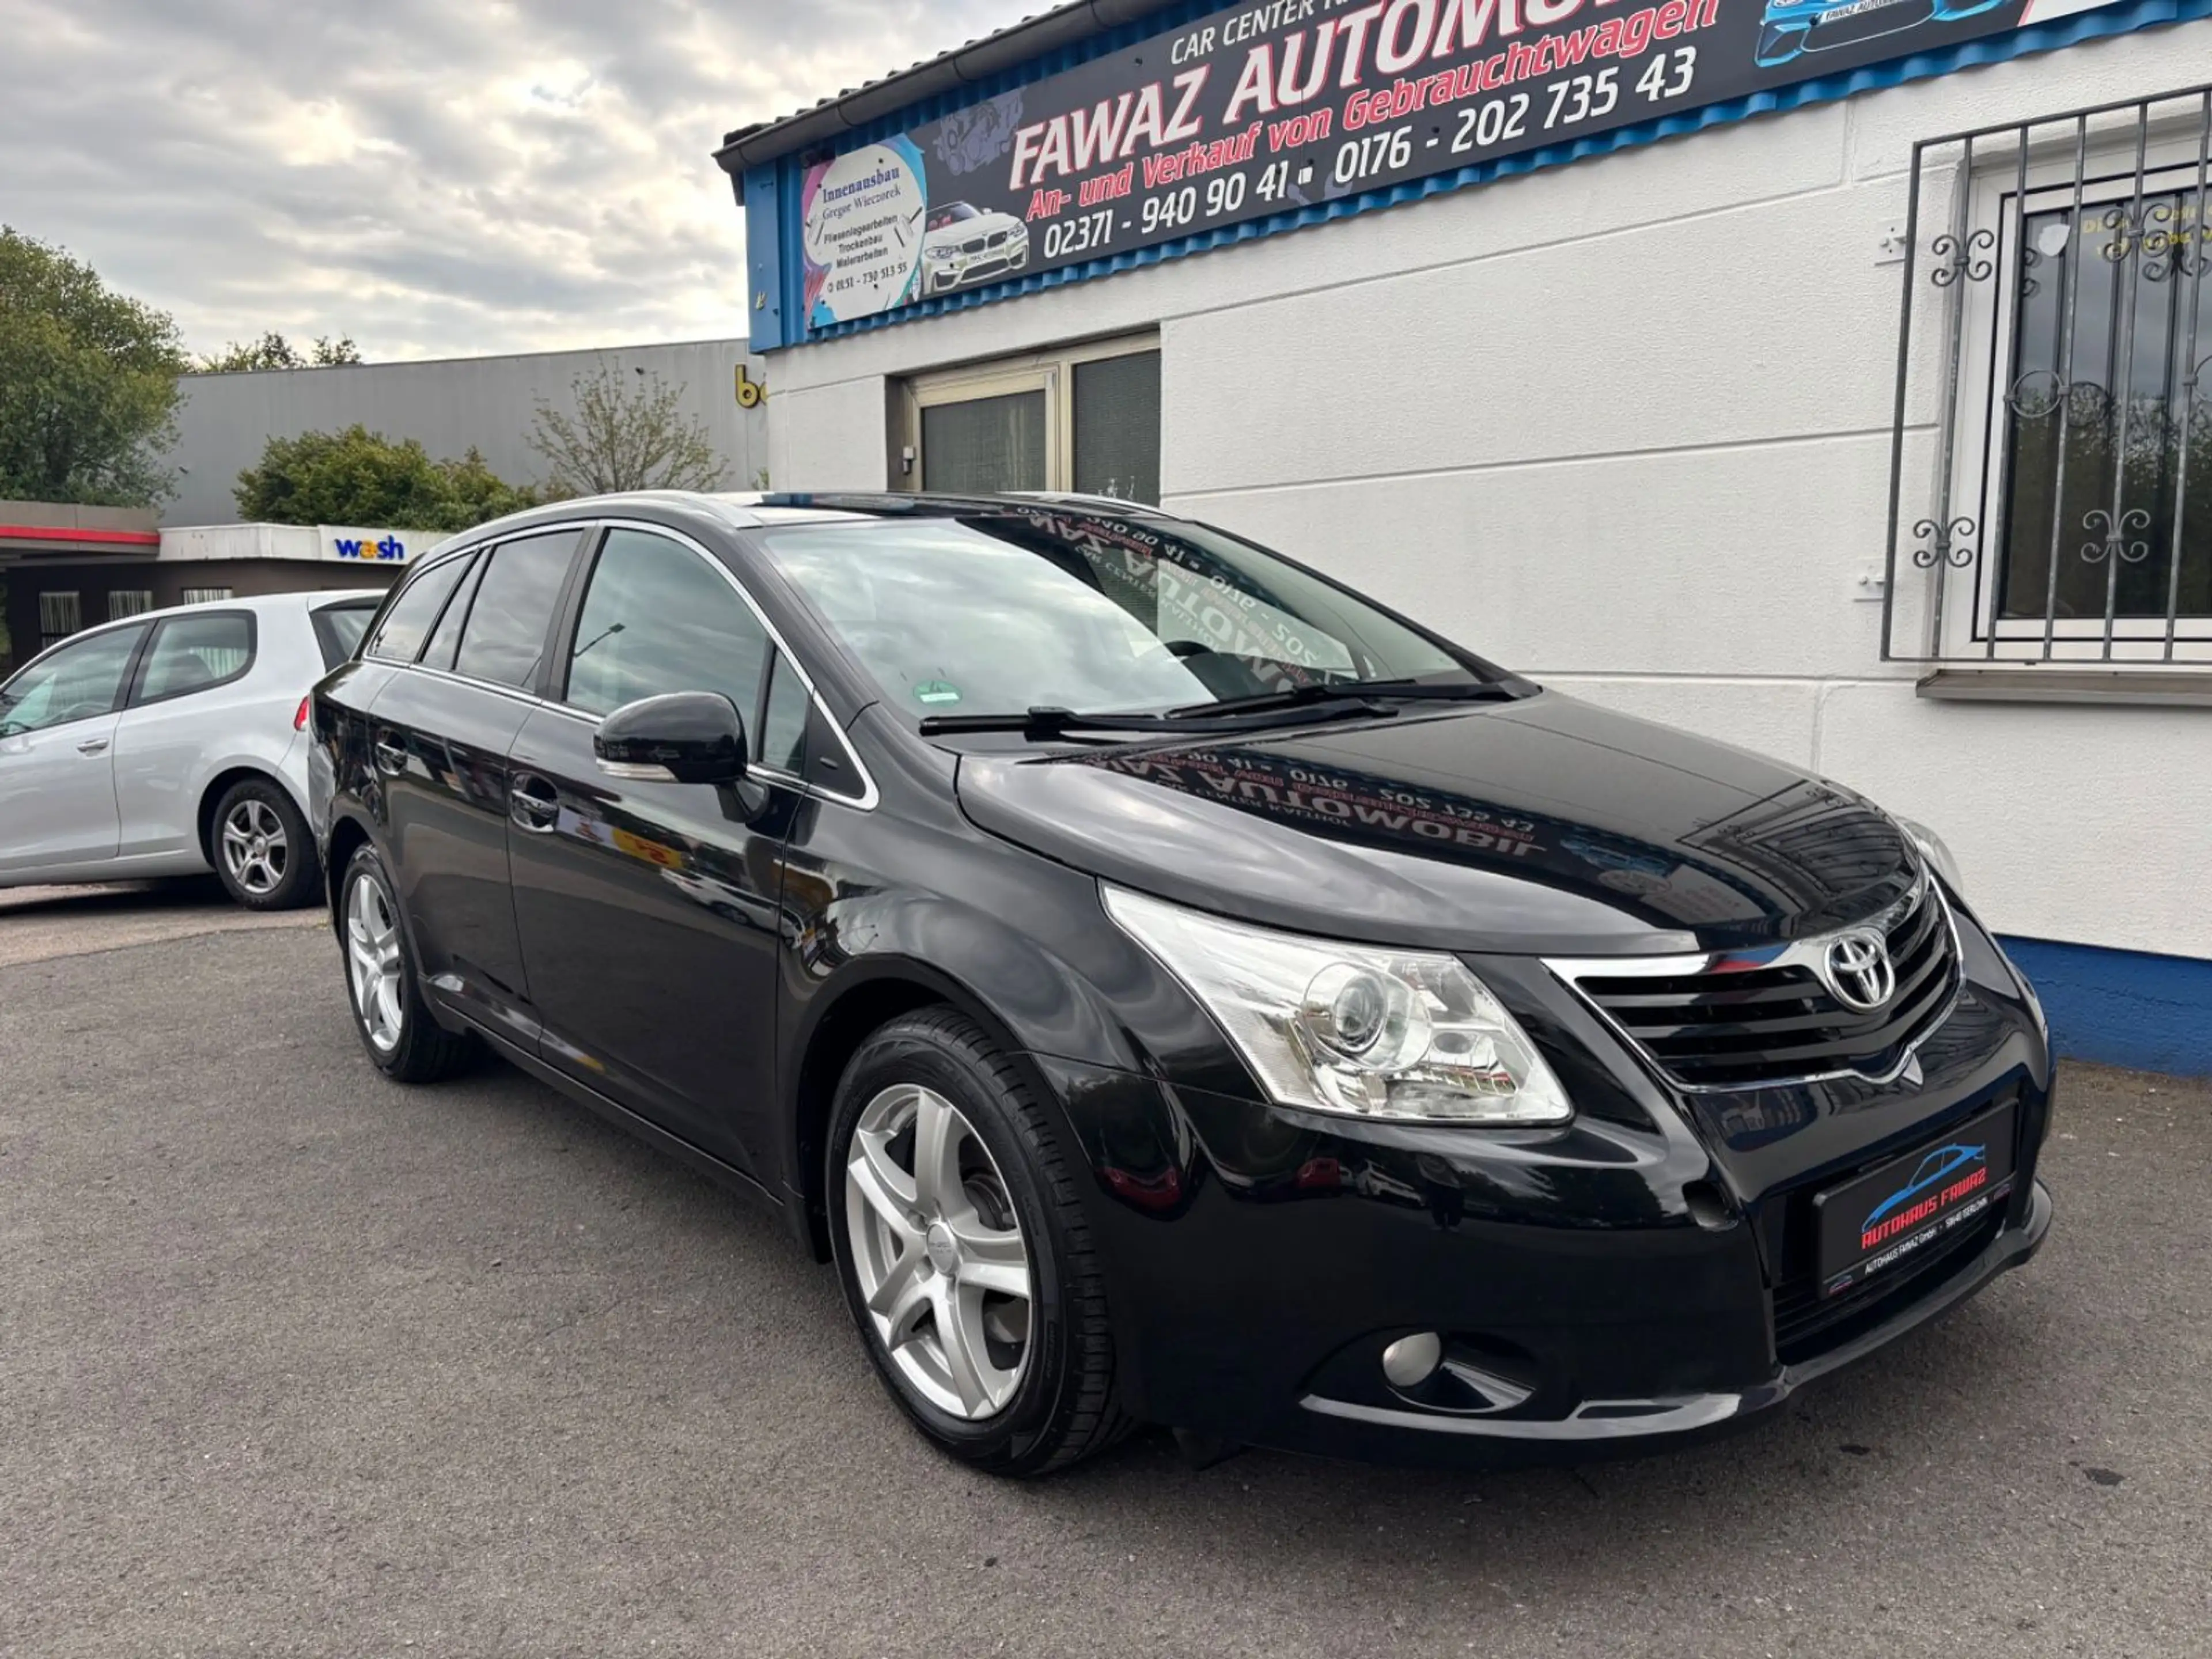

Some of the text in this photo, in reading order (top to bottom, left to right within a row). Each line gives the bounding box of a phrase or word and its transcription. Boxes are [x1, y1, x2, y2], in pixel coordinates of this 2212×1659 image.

[1171, 0, 1315, 65] CAR CENTER
[1009, 64, 1211, 191] FAWAZ
[1026, 0, 1717, 221] An- und Verkauf von Gebrauchtwagen
[823, 166, 900, 203] Innenausbau
[1044, 210, 1113, 258] 02371
[1141, 186, 1196, 234] 940
[1205, 172, 1247, 217] 90
[1256, 160, 1288, 202] 41
[1335, 126, 1412, 183] 0176
[1451, 93, 1531, 154] 202
[1543, 66, 1619, 130] 735
[1635, 46, 1697, 101] 43
[839, 235, 883, 253] Trockenbau
[334, 535, 404, 560] wash
[1861, 1196, 1938, 1249] AUTOHAUS
[1941, 1166, 1987, 1207] FAWAZ
